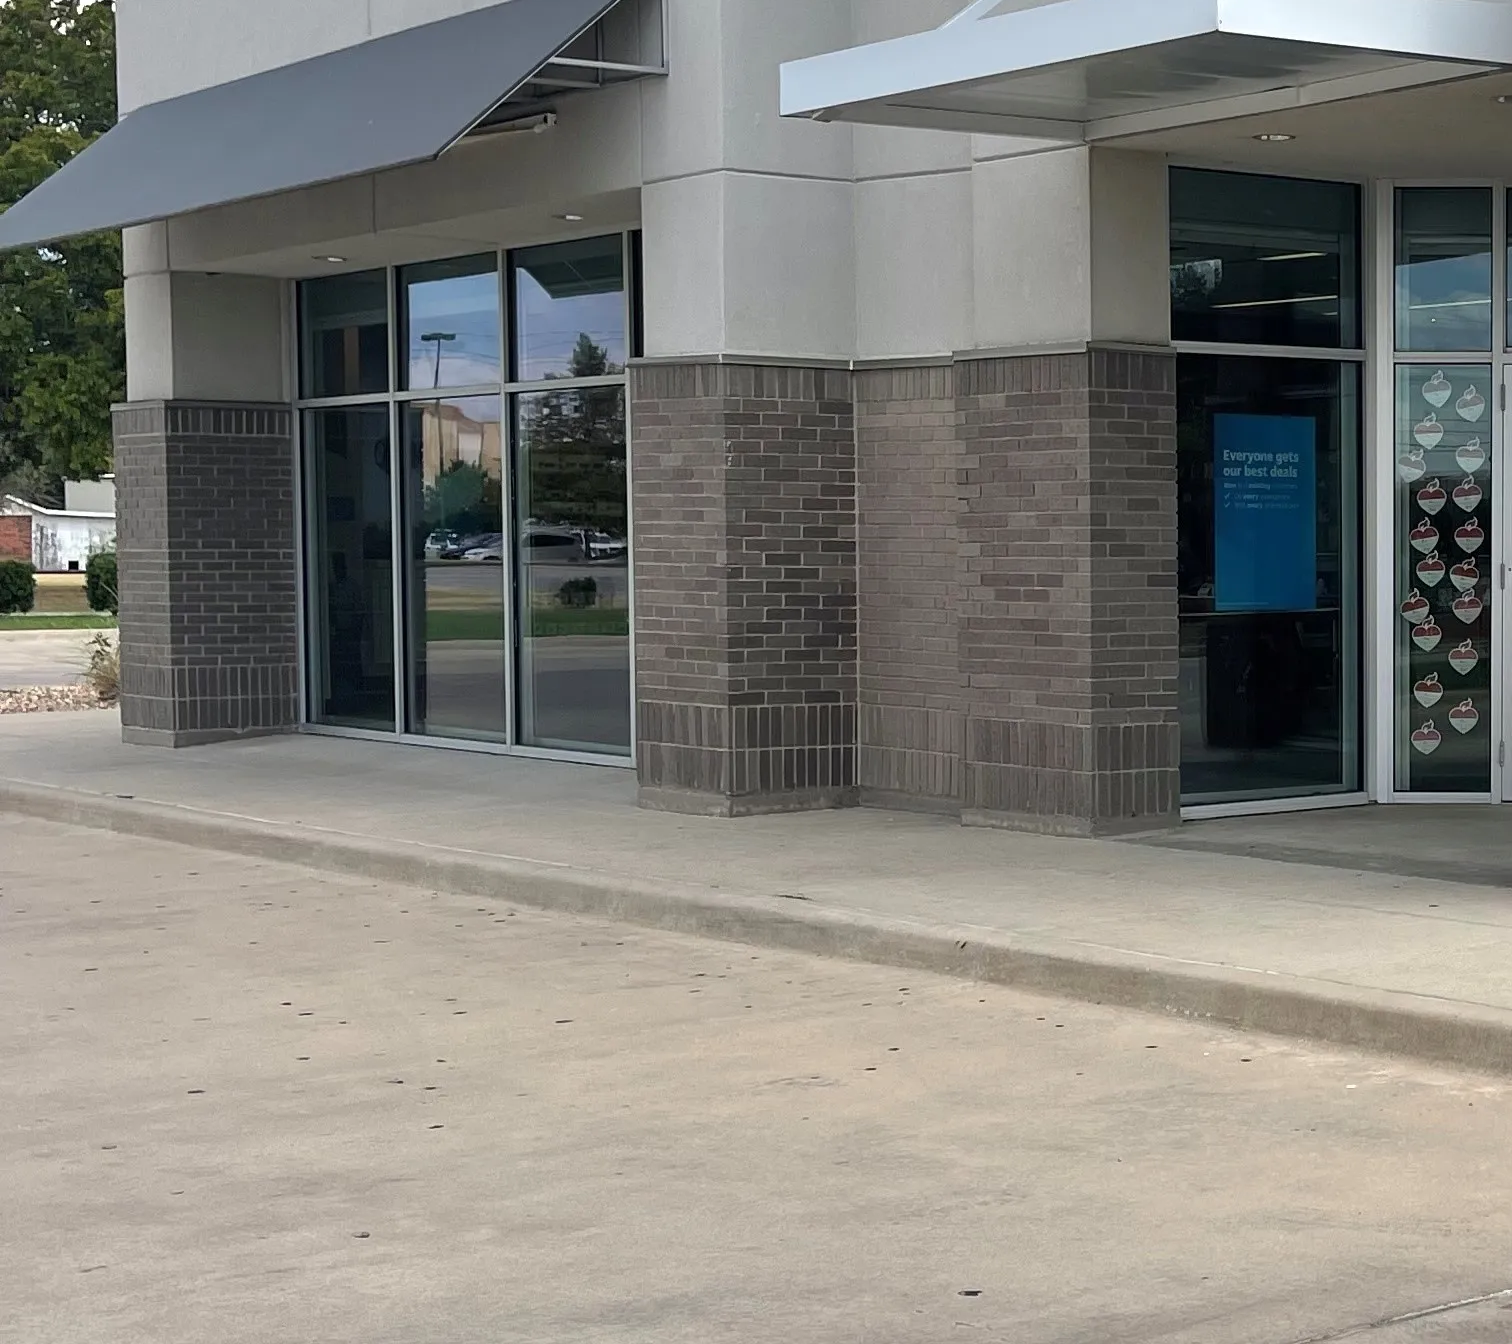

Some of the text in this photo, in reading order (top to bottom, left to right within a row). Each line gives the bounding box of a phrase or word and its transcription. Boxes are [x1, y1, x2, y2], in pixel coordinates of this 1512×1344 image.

[1223, 449, 1299, 465] Everyone gets
[1223, 465, 1298, 477] our best deals
